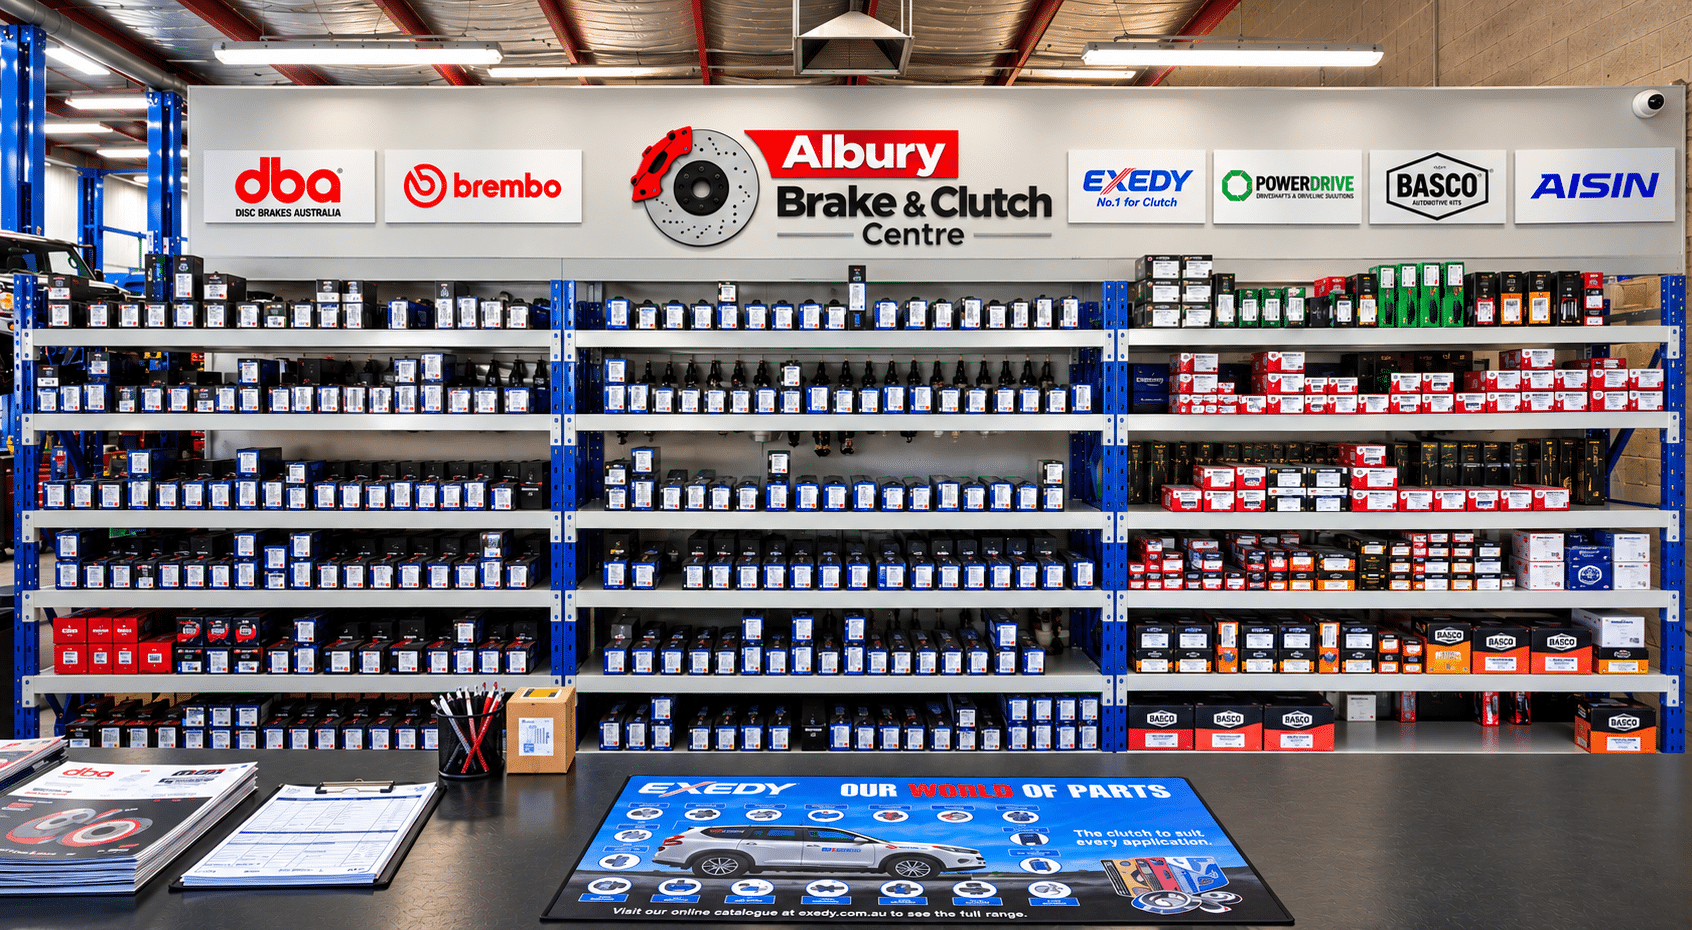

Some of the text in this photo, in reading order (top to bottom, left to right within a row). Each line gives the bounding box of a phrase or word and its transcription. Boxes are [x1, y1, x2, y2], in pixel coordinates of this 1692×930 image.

[782, 134, 946, 177] Albury
[235, 157, 341, 204] dba
[454, 172, 561, 199] brembo
[1083, 168, 1194, 195] EXEDY
[1256, 176, 1355, 191] POWERDRIVE
[1394, 171, 1477, 198] BASCO
[1531, 173, 1660, 199] AISIN
[777, 185, 1052, 217] Brake & Clutch
[1096, 196, 1178, 208] No.1 for Clutch
[236, 208, 341, 218] DISC BRAKES AUSTRALIA
[862, 222, 965, 246] Centre
[1216, 714, 1242, 723] BASCO
[63, 767, 115, 778] dba
[638, 781, 797, 798] EXEDY
[840, 783, 1172, 799] OUR WORLD OF PARTS
[1106, 829, 1153, 838] clutch
[1155, 829, 1172, 838] to
[1076, 840, 1118, 849] every
[613, 907, 642, 916] Visit
[644, 908, 668, 916] our
[670, 908, 711, 916] online
[714, 908, 778, 919] catalogue
[781, 909, 796, 917] at
[890, 910, 904, 918] to
